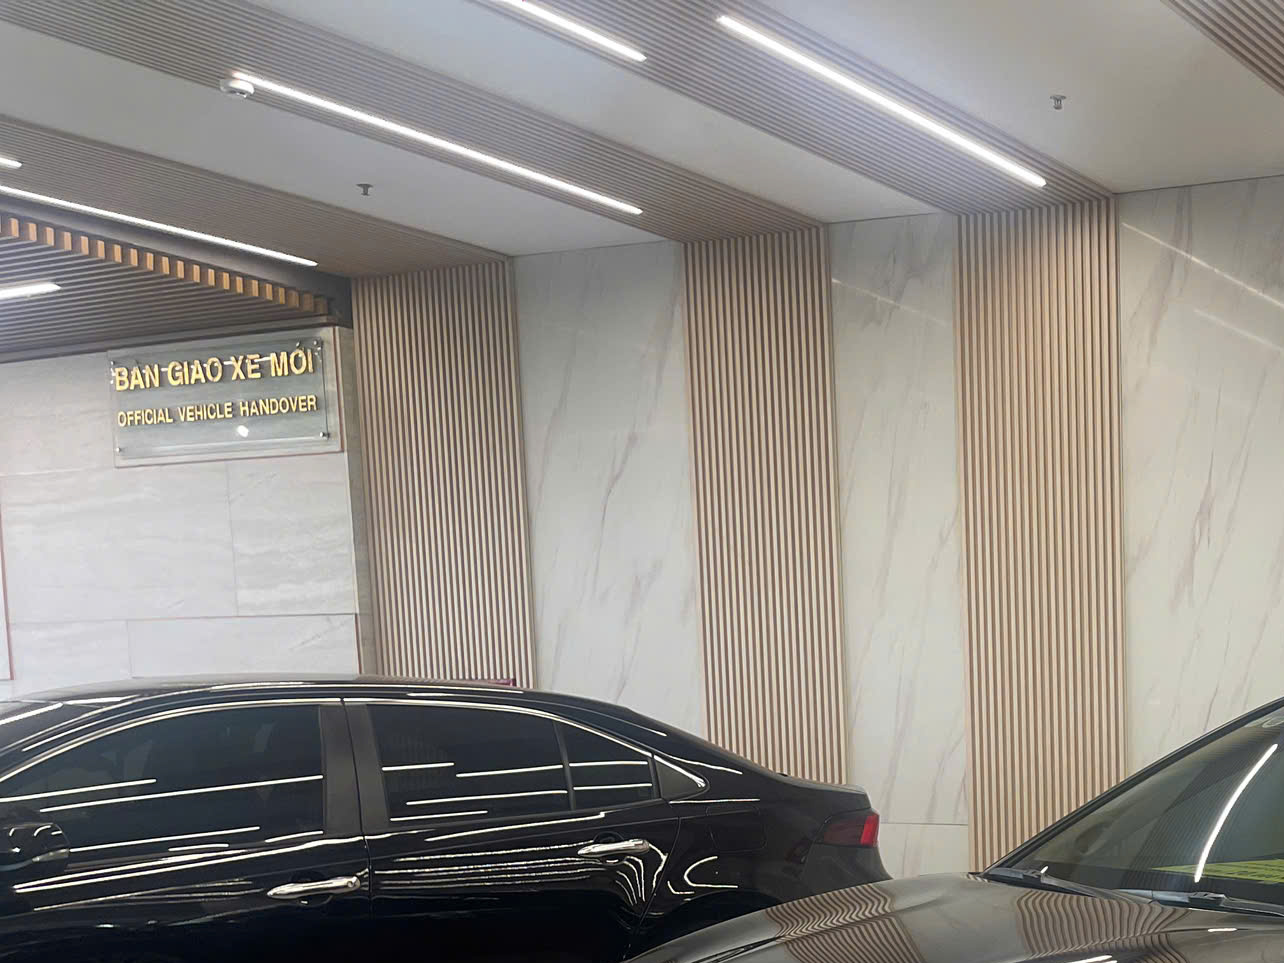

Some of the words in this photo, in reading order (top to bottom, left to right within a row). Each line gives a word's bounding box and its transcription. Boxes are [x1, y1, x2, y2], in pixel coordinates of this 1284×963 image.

[167, 356, 223, 387] GIAO
[230, 353, 261, 381] XE
[117, 407, 174, 428] OFFICIAL
[177, 402, 233, 423] VEHICLE
[239, 394, 317, 418] HANDOVER
